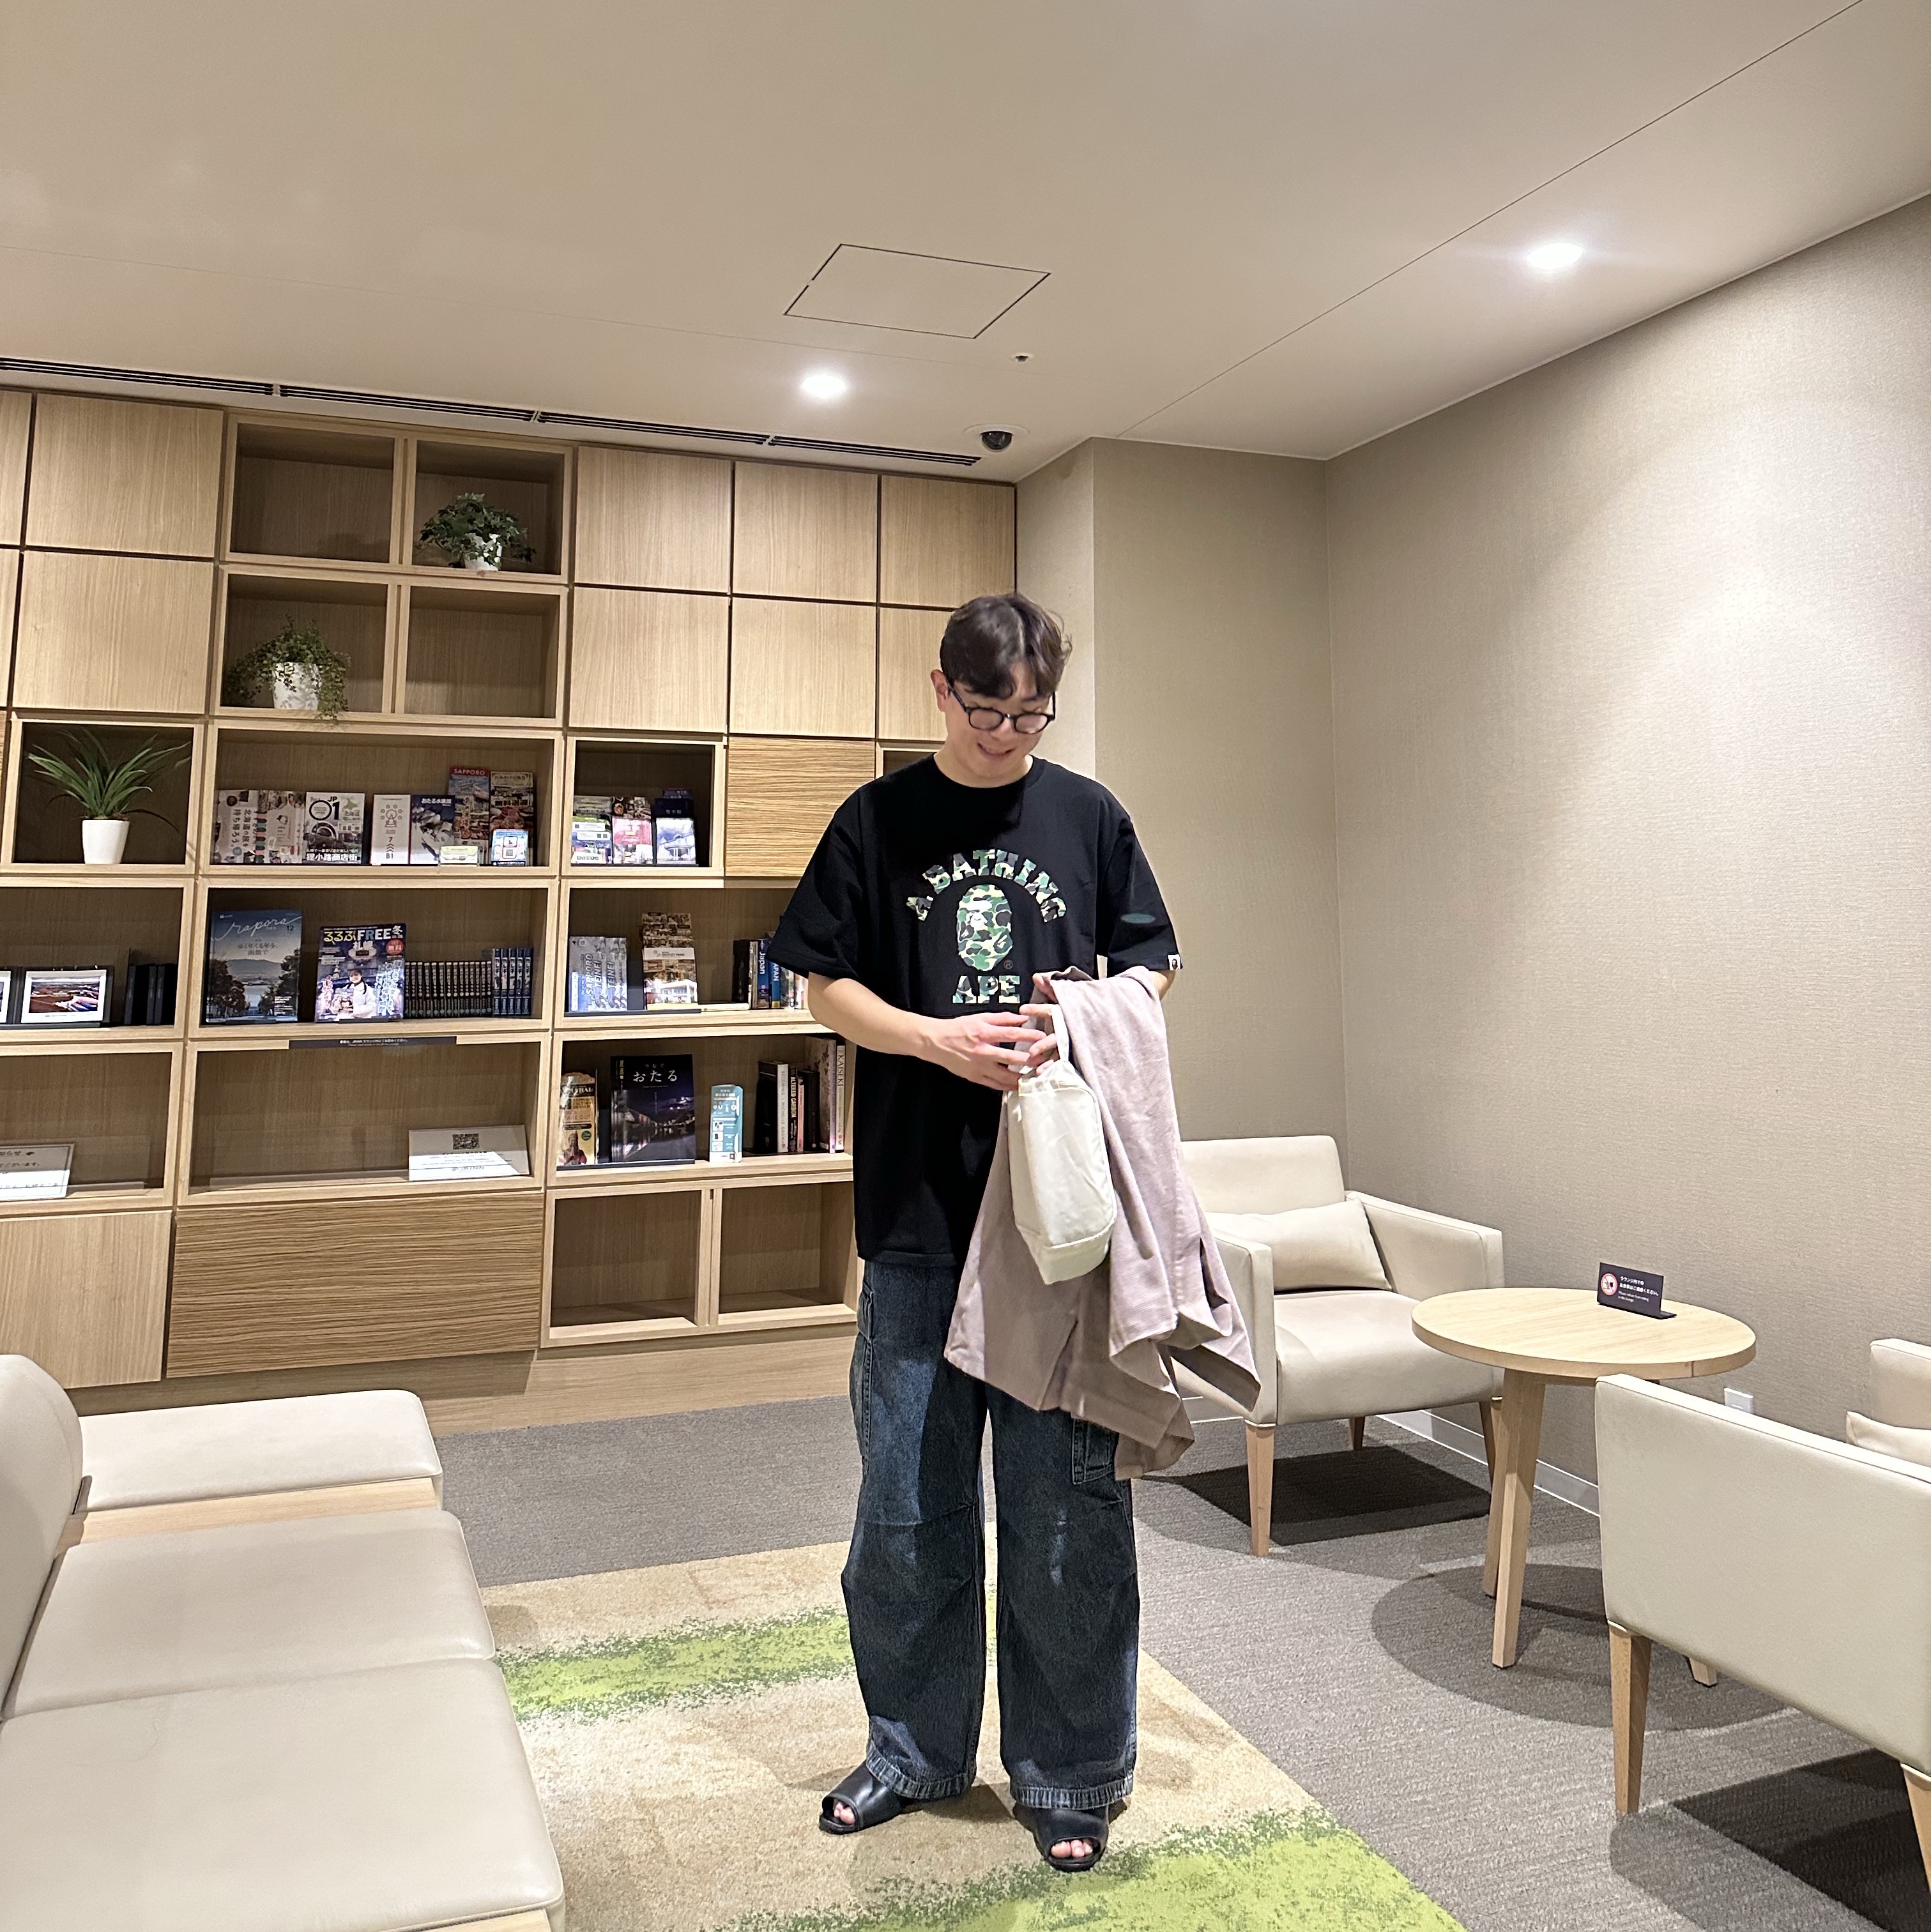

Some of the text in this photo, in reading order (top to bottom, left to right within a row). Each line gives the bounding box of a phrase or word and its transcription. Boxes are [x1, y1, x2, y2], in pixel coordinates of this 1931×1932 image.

[906, 849, 1067, 923] A BATHING
[357, 928, 392, 941] FREE
[585, 953, 594, 995] SAPPORO
[952, 975, 1021, 1004] APE
[632, 1070, 678, 1083] おたる
